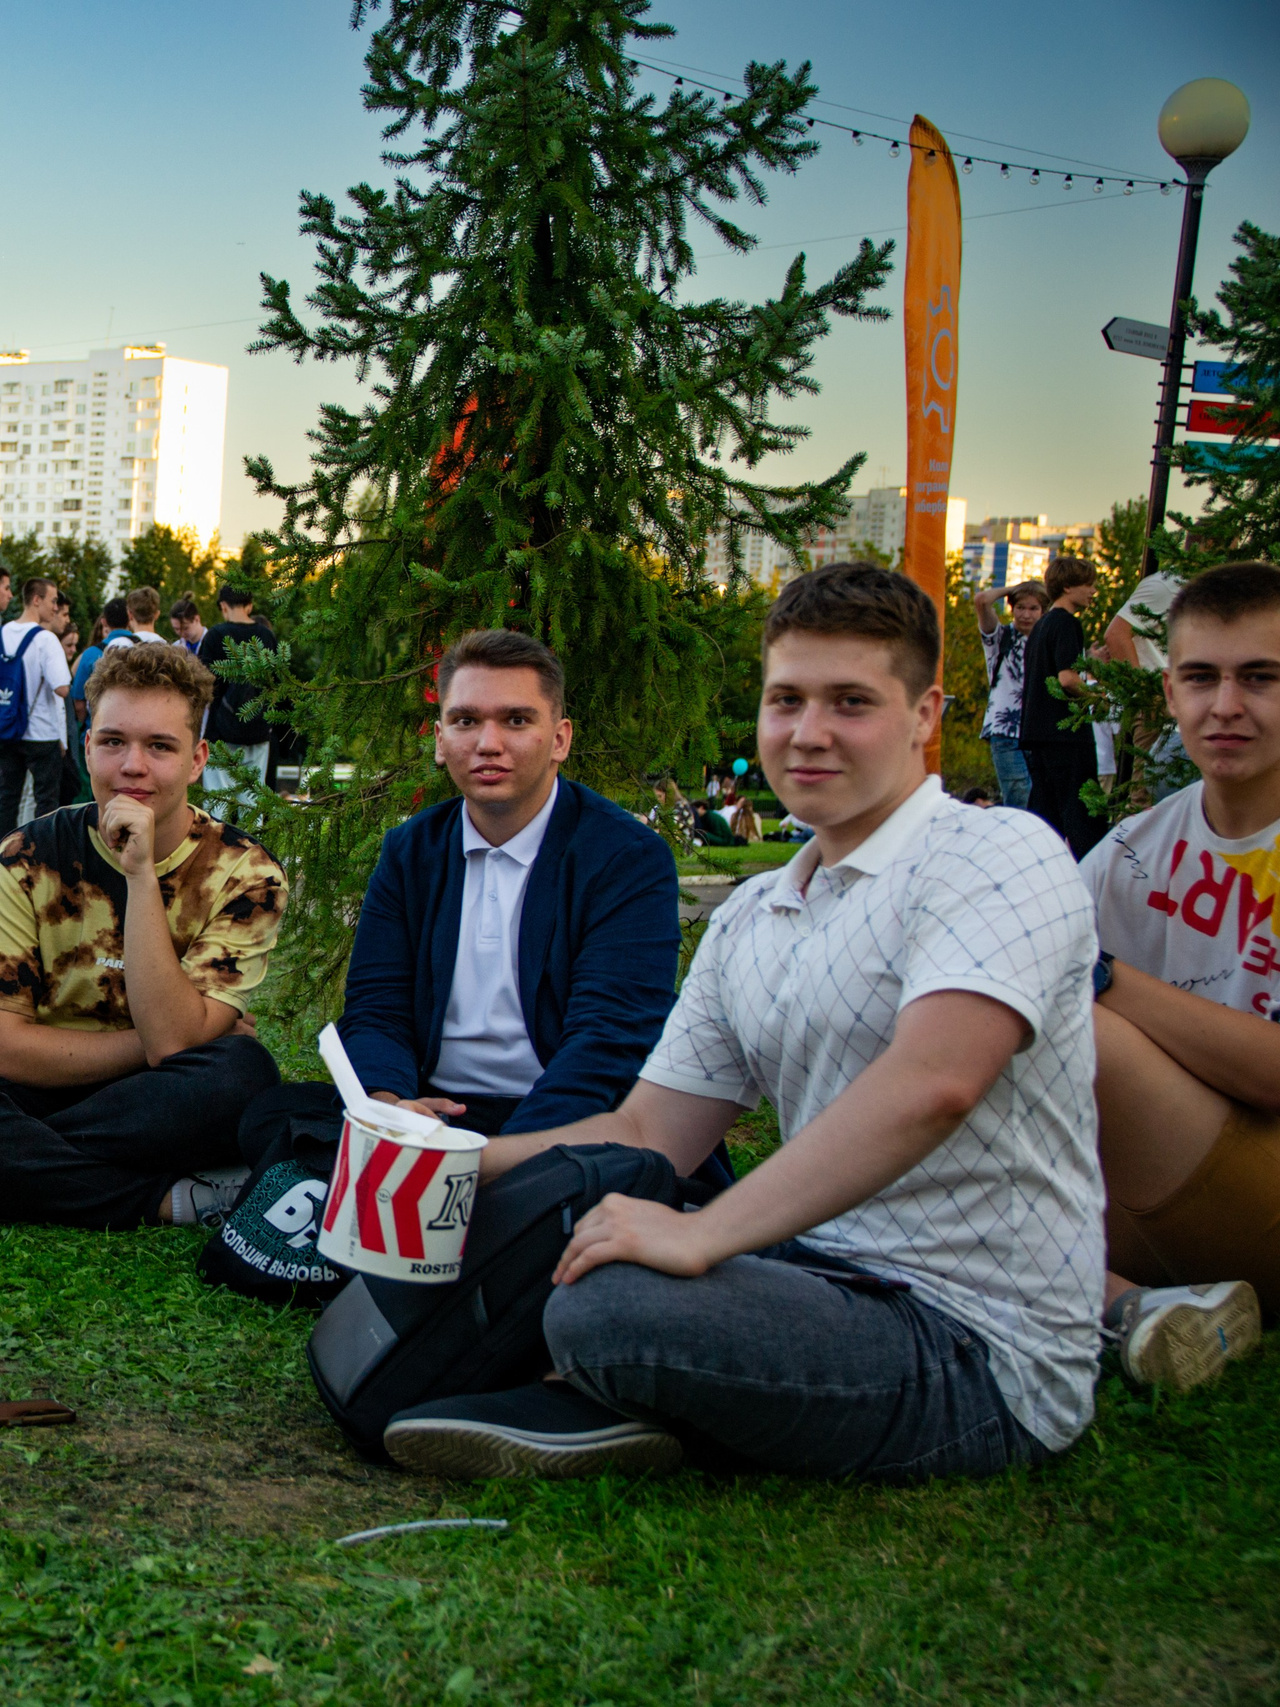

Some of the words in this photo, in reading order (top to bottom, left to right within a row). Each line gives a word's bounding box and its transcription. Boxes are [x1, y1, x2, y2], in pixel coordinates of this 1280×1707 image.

[914, 498, 947, 516] ибербе
[95, 957, 125, 970] PAR
[221, 1222, 271, 1273] БОЛЬШИЕ
